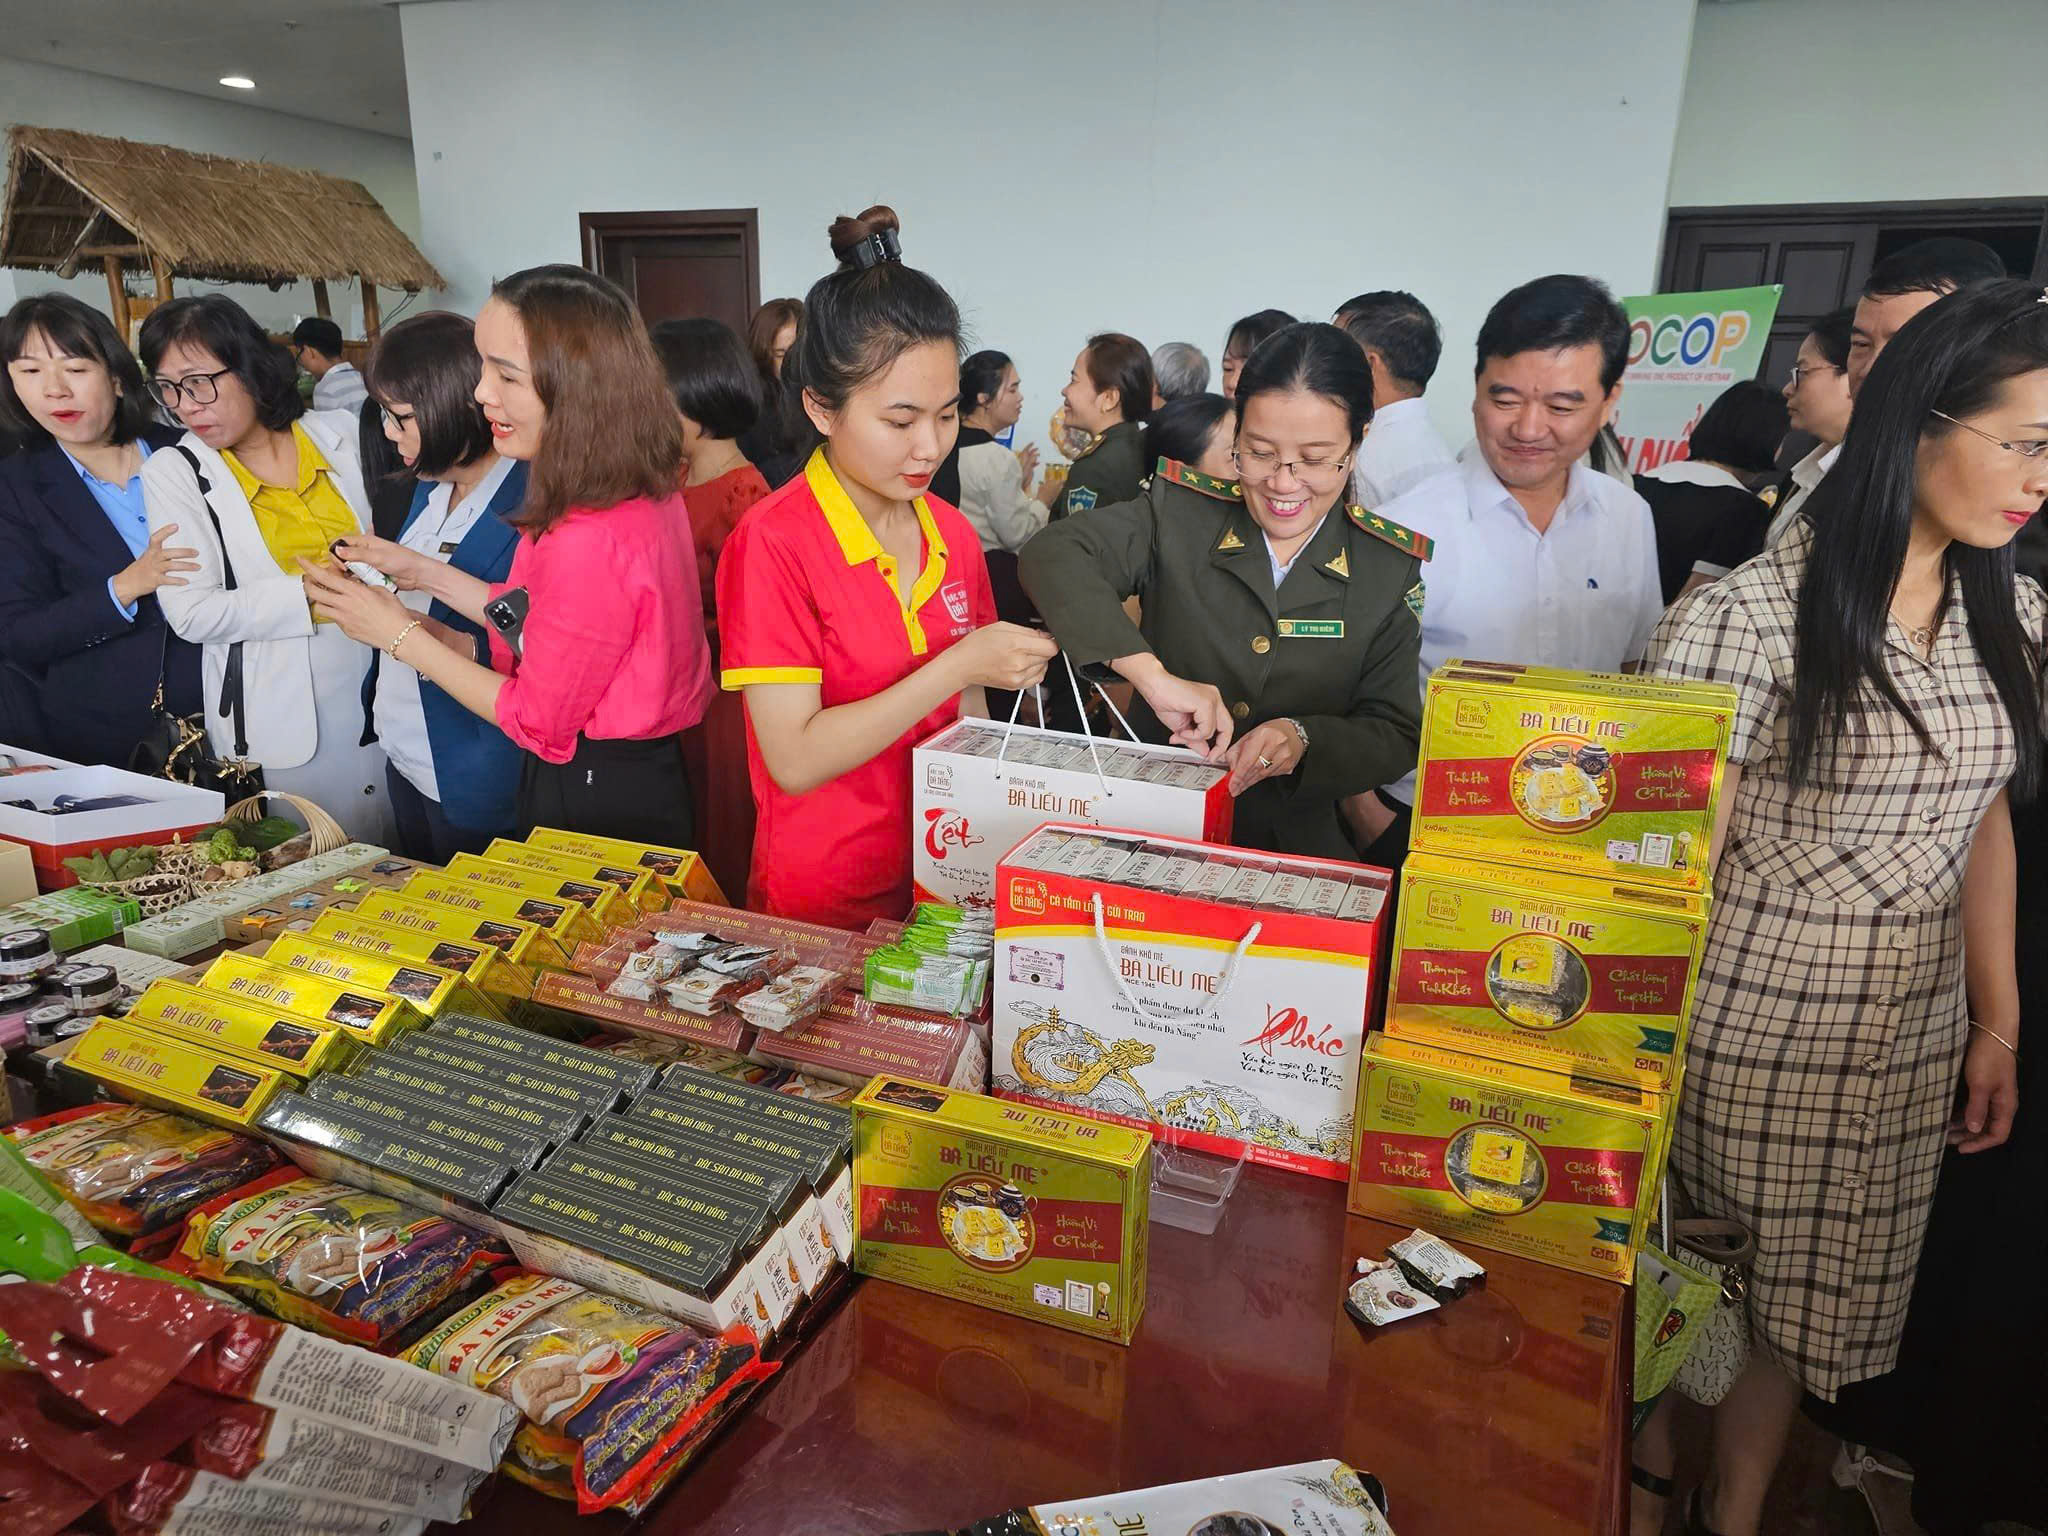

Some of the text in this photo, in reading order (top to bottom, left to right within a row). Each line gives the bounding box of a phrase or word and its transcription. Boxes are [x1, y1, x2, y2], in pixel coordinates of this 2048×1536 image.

[1069, 798, 1092, 820] MẸ
[924, 807, 984, 860] Tết
[1062, 895, 1080, 910] TẤM
[1124, 908, 1145, 922] TRAO
[1192, 972, 1218, 996] MẸ
[1240, 1003, 1352, 1058] Phúc
[1512, 1029, 1548, 1041] SPECIAL
[448, 1341, 482, 1374] BÀ
